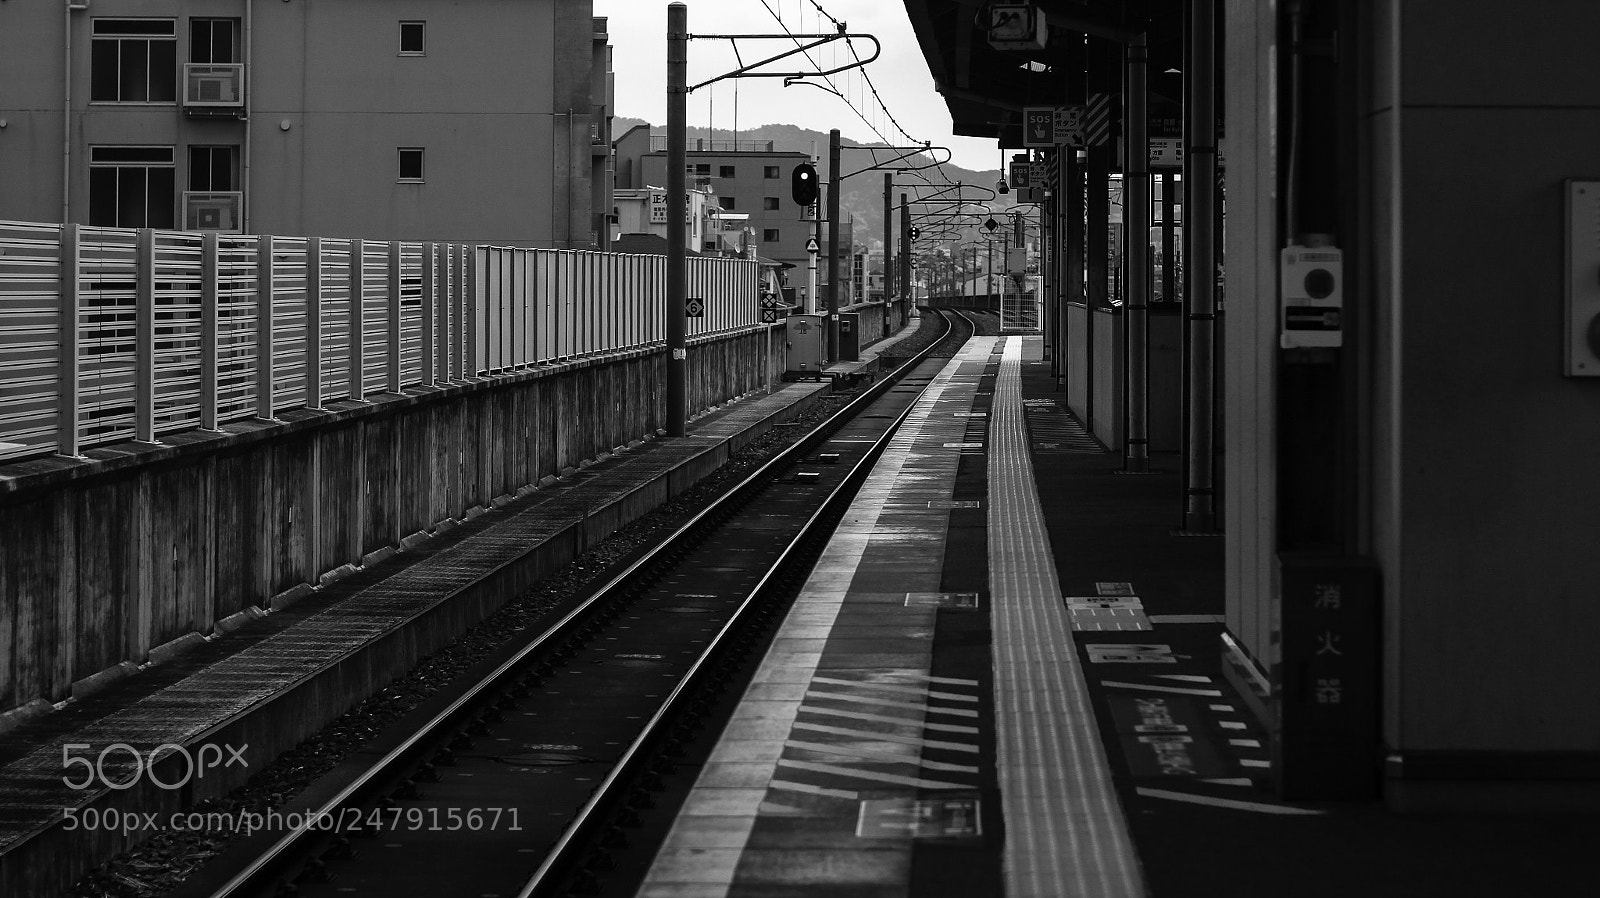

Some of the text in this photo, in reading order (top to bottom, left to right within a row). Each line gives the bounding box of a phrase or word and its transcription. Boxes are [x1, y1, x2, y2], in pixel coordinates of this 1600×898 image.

[1030, 115, 1050, 123] SOS
[808, 207, 814, 216] 2
[690, 302, 698, 313] 6
[1313, 583, 1343, 704] 消火器
